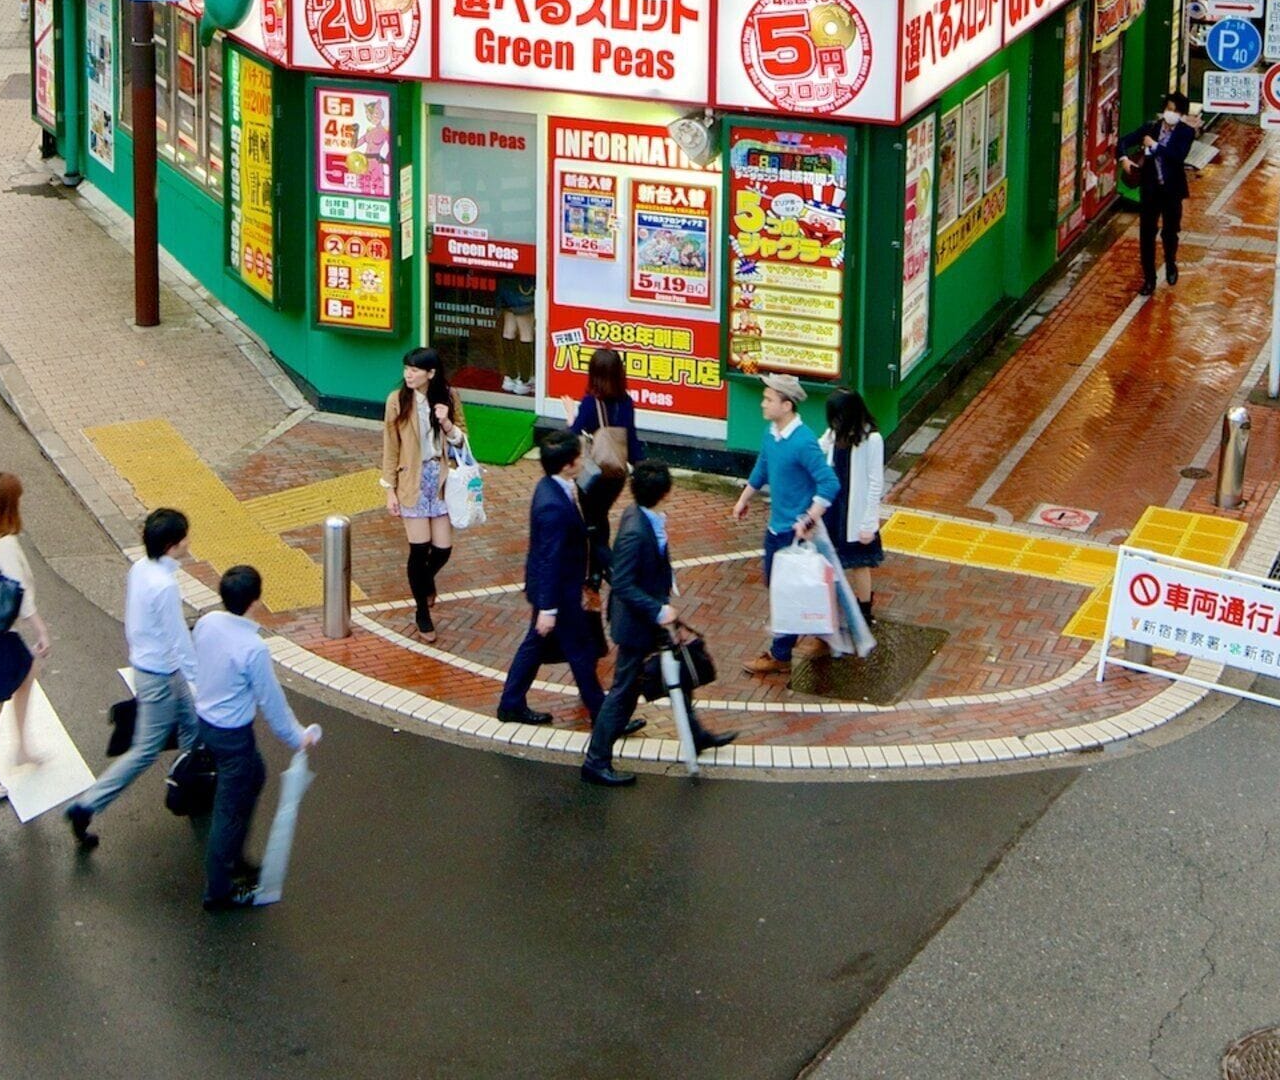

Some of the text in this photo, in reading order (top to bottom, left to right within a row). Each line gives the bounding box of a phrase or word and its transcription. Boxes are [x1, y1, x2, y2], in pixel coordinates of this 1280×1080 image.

[338, 46, 408, 65] スロット
[475, 27, 676, 81] Green Peas
[1219, 29, 1240, 62] P
[1232, 48, 1248, 64] 40
[773, 83, 853, 102] スロット
[326, 97, 352, 116] 5F
[324, 120, 355, 138] 4倍
[441, 126, 526, 151] Green Peas
[554, 127, 721, 171] INFORMAT
[565, 174, 613, 191] 新台入替
[230, 124, 241, 269] Green Peas
[637, 184, 707, 209] 新台入替
[448, 238, 520, 261] Green Peas
[736, 232, 841, 264] ジャグラー
[586, 321, 692, 351] 1988年創業
[554, 344, 722, 387] パロ専門店
[640, 388, 674, 407] Peas
